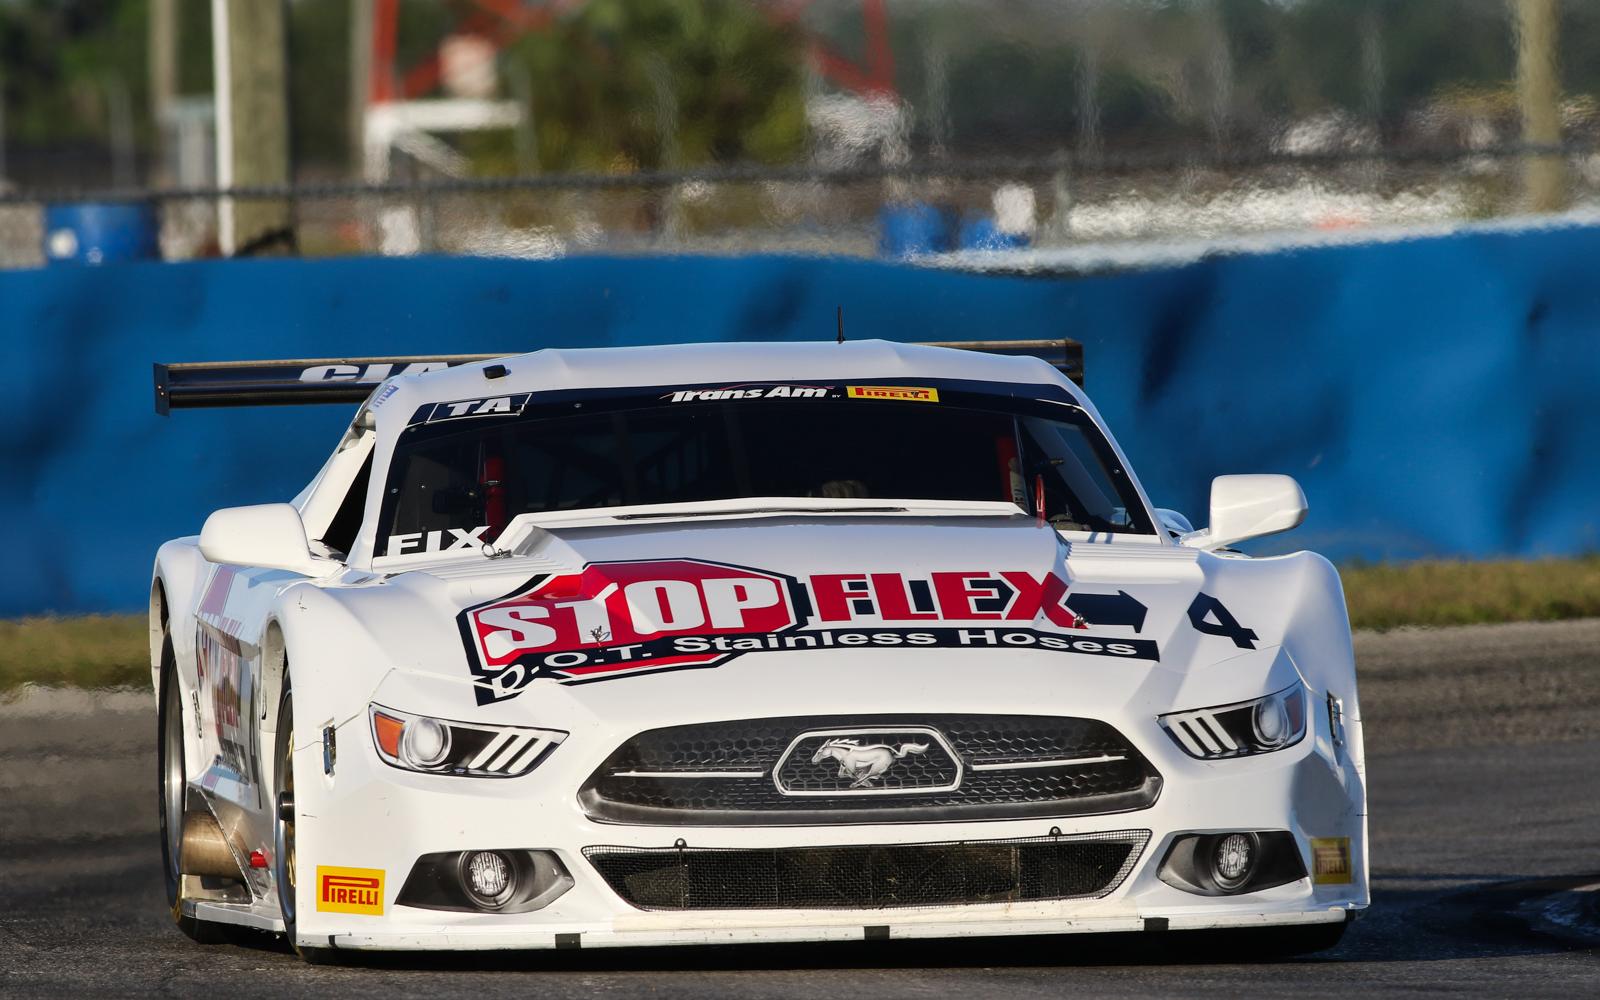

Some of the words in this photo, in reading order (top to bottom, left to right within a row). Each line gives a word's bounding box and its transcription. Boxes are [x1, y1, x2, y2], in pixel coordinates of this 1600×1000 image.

[447, 397, 511, 416] TA
[671, 388, 764, 402] Trans
[764, 386, 828, 399] Am
[855, 387, 930, 400] PIRELLI
[386, 525, 492, 556] FIX
[478, 578, 780, 660] STOP
[808, 571, 1089, 630] FLEX
[1187, 591, 1260, 650] 4
[673, 631, 938, 652] Stainless
[958, 629, 1138, 656] Hoses
[322, 875, 380, 906] PIRELLI
